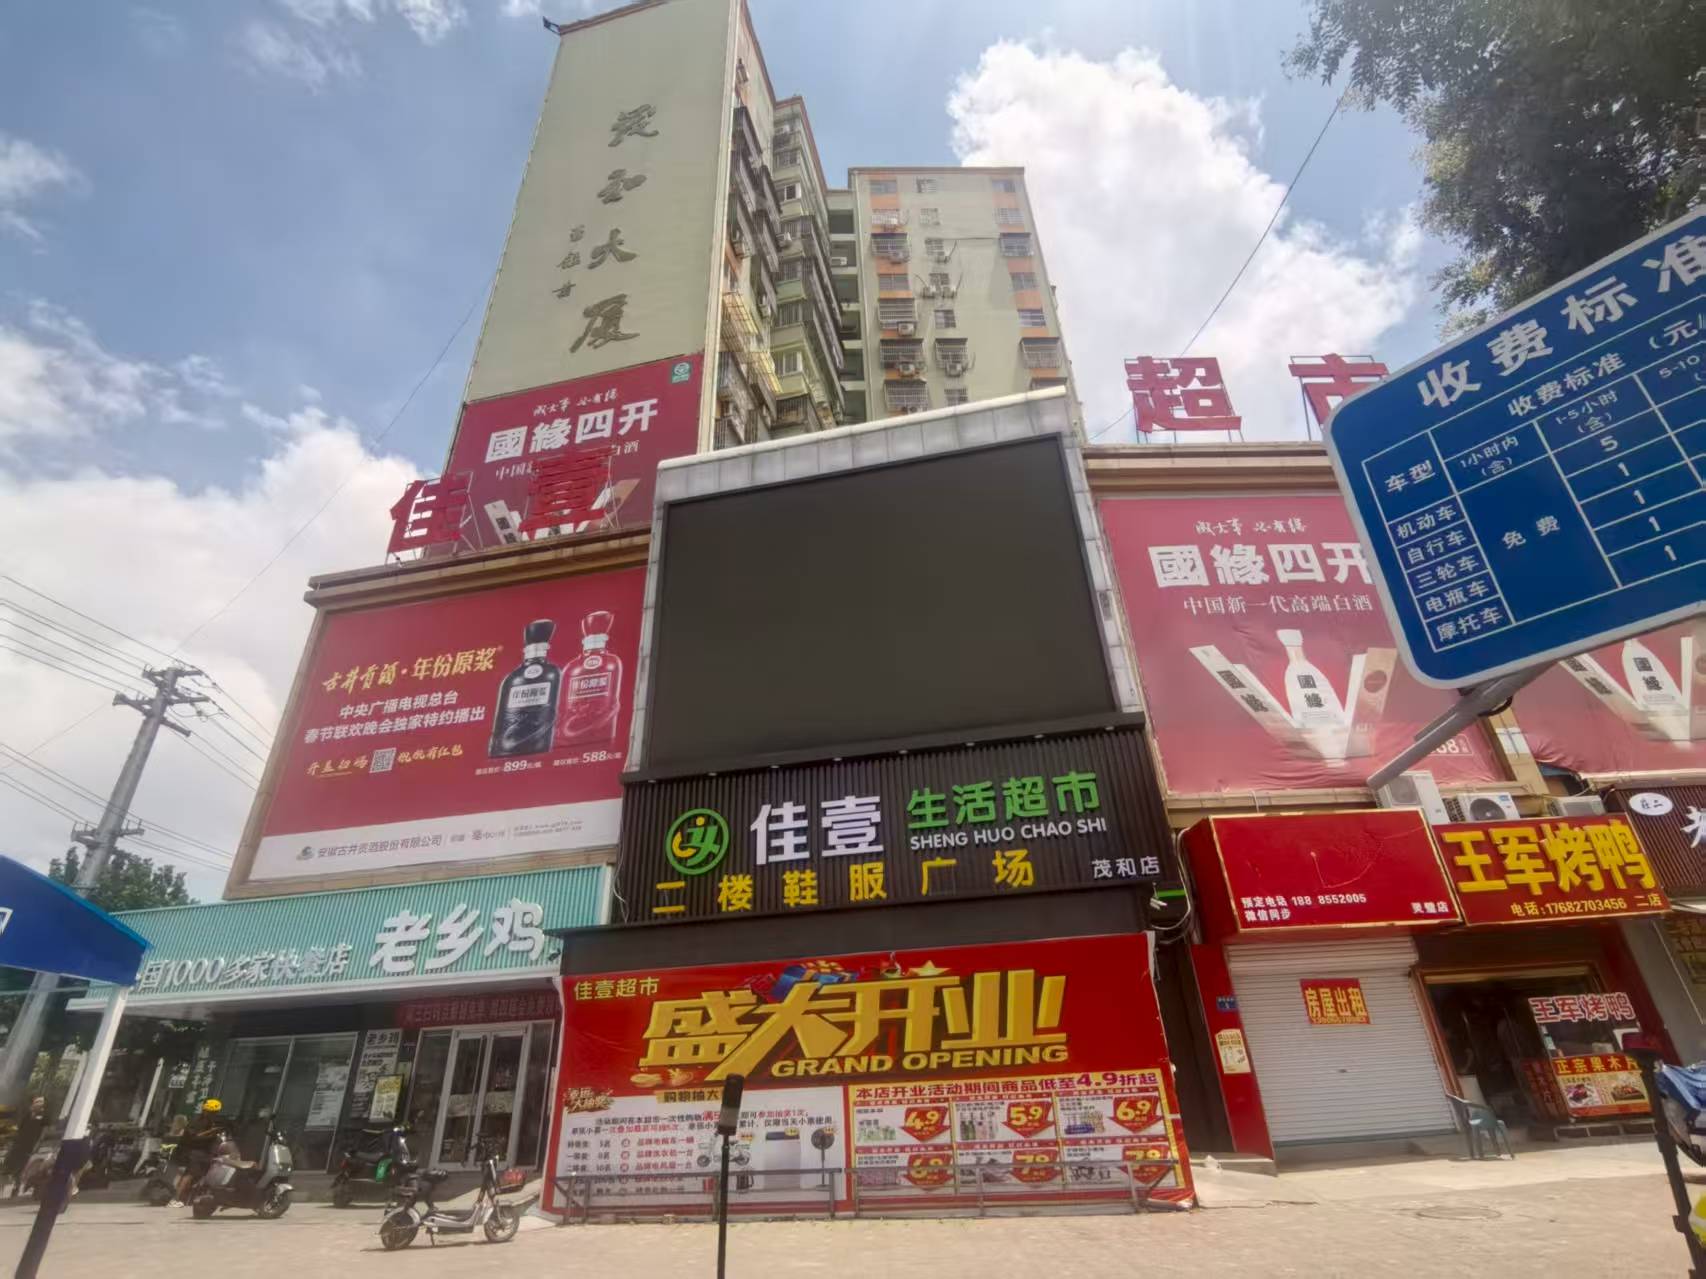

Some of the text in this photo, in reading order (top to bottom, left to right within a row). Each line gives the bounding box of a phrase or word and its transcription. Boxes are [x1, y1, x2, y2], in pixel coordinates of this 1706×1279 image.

[1417, 234, 1706, 408] 收费标准
[1507, 351, 1626, 417] 收费标准
[1600, 435, 1619, 452] 5
[1384, 459, 1436, 494] 车型
[1617, 461, 1631, 477] 1
[1633, 489, 1646, 505] 1
[1396, 504, 1661, 539] 机动车 1
[1407, 515, 1677, 564] 自行车 免费 1
[1416, 555, 1479, 589] 三轮车
[1183, 595, 1373, 616] 中国新一代高端白酒
[1425, 580, 1489, 613] 电瓶车
[1436, 606, 1503, 643] 摩托车
[338, 690, 459, 720] 中央广播电视总台
[303, 706, 486, 744] 春节联欢晚会独家特约播出
[503, 760, 528, 772] 899
[582, 751, 608, 763] 588
[750, 770, 1101, 865] 佳壹 生活超市
[909, 816, 1108, 851] SHENG HUO CHAO SHI
[1441, 818, 1657, 896] 王军烤鸭
[652, 849, 1161, 914] 二楼鞋服广场 茂和店
[1241, 896, 1288, 909] 预定电话
[1291, 896, 1312, 906] 188
[1633, 893, 1662, 907] 二店
[369, 898, 545, 974] 老乡鸡
[573, 976, 660, 1000] 佳壹超市
[1305, 987, 1367, 1018] 房屋出租
[1528, 992, 1636, 1023] 王军烤鸭
[638, 968, 1068, 1081] 盛大开业
[771, 1045, 1069, 1078] GRAND OPENING
[856, 1072, 1158, 1098] 本店开业活动期间商品低至4.9折起
[906, 1111, 939, 1130] 4.9
[1009, 1105, 1042, 1126] 5.9
[1116, 1100, 1151, 1121] 6.9
